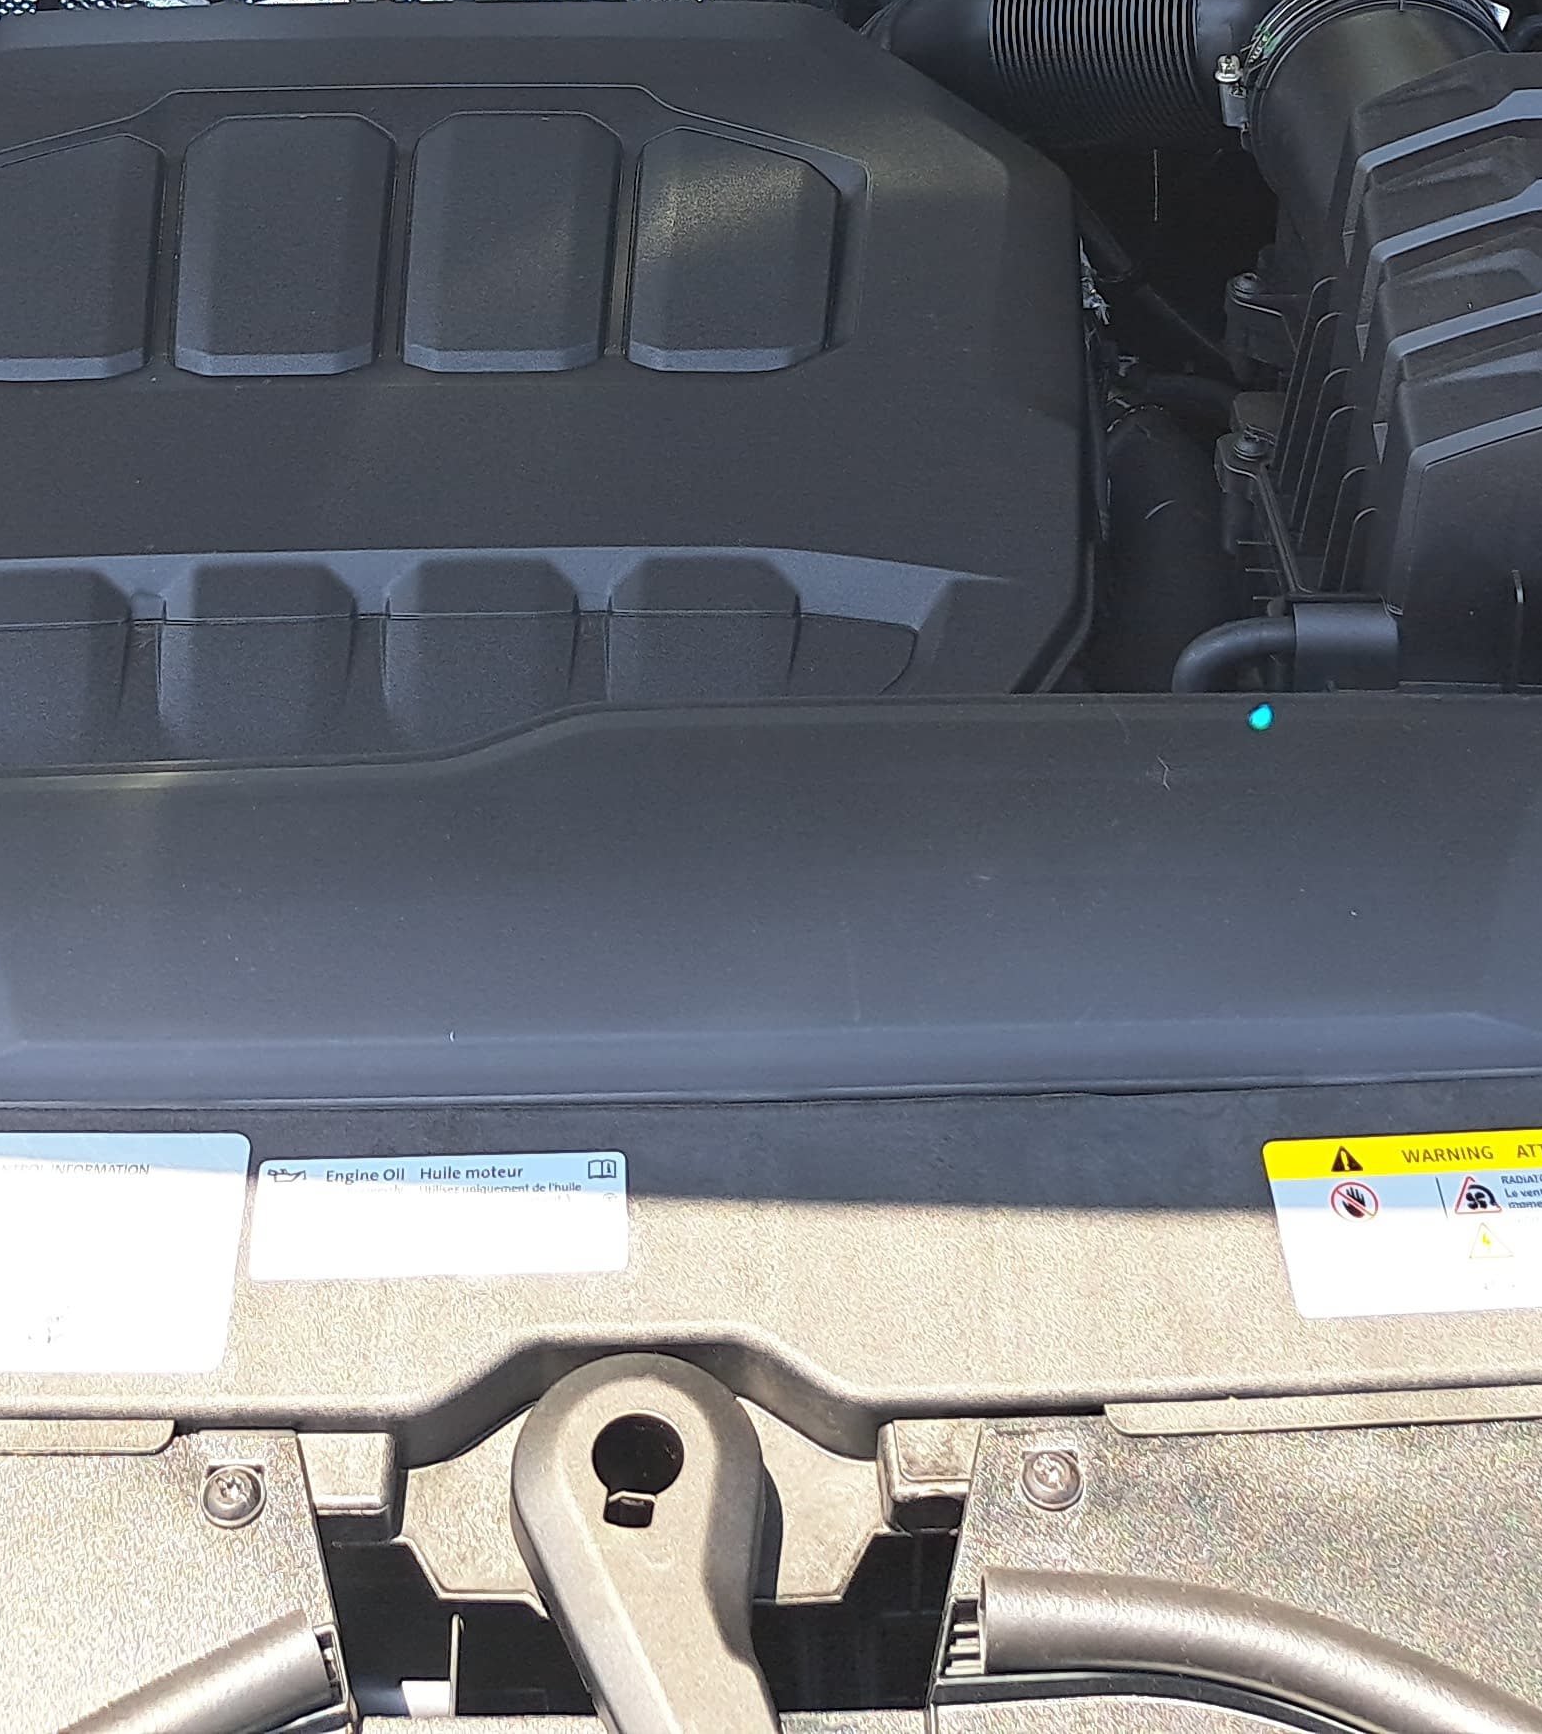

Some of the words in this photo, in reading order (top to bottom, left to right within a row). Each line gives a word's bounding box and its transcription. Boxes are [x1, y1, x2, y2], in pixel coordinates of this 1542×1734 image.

[1401, 1145, 1494, 1164] WARNING
[326, 1169, 379, 1185] Engine
[383, 1168, 405, 1181] Oil
[420, 1167, 461, 1180] Huile
[465, 1166, 524, 1180] moteur
[532, 1182, 546, 1193] de
[549, 1181, 582, 1192] l'huile
[1504, 1187, 1518, 1198] Le
